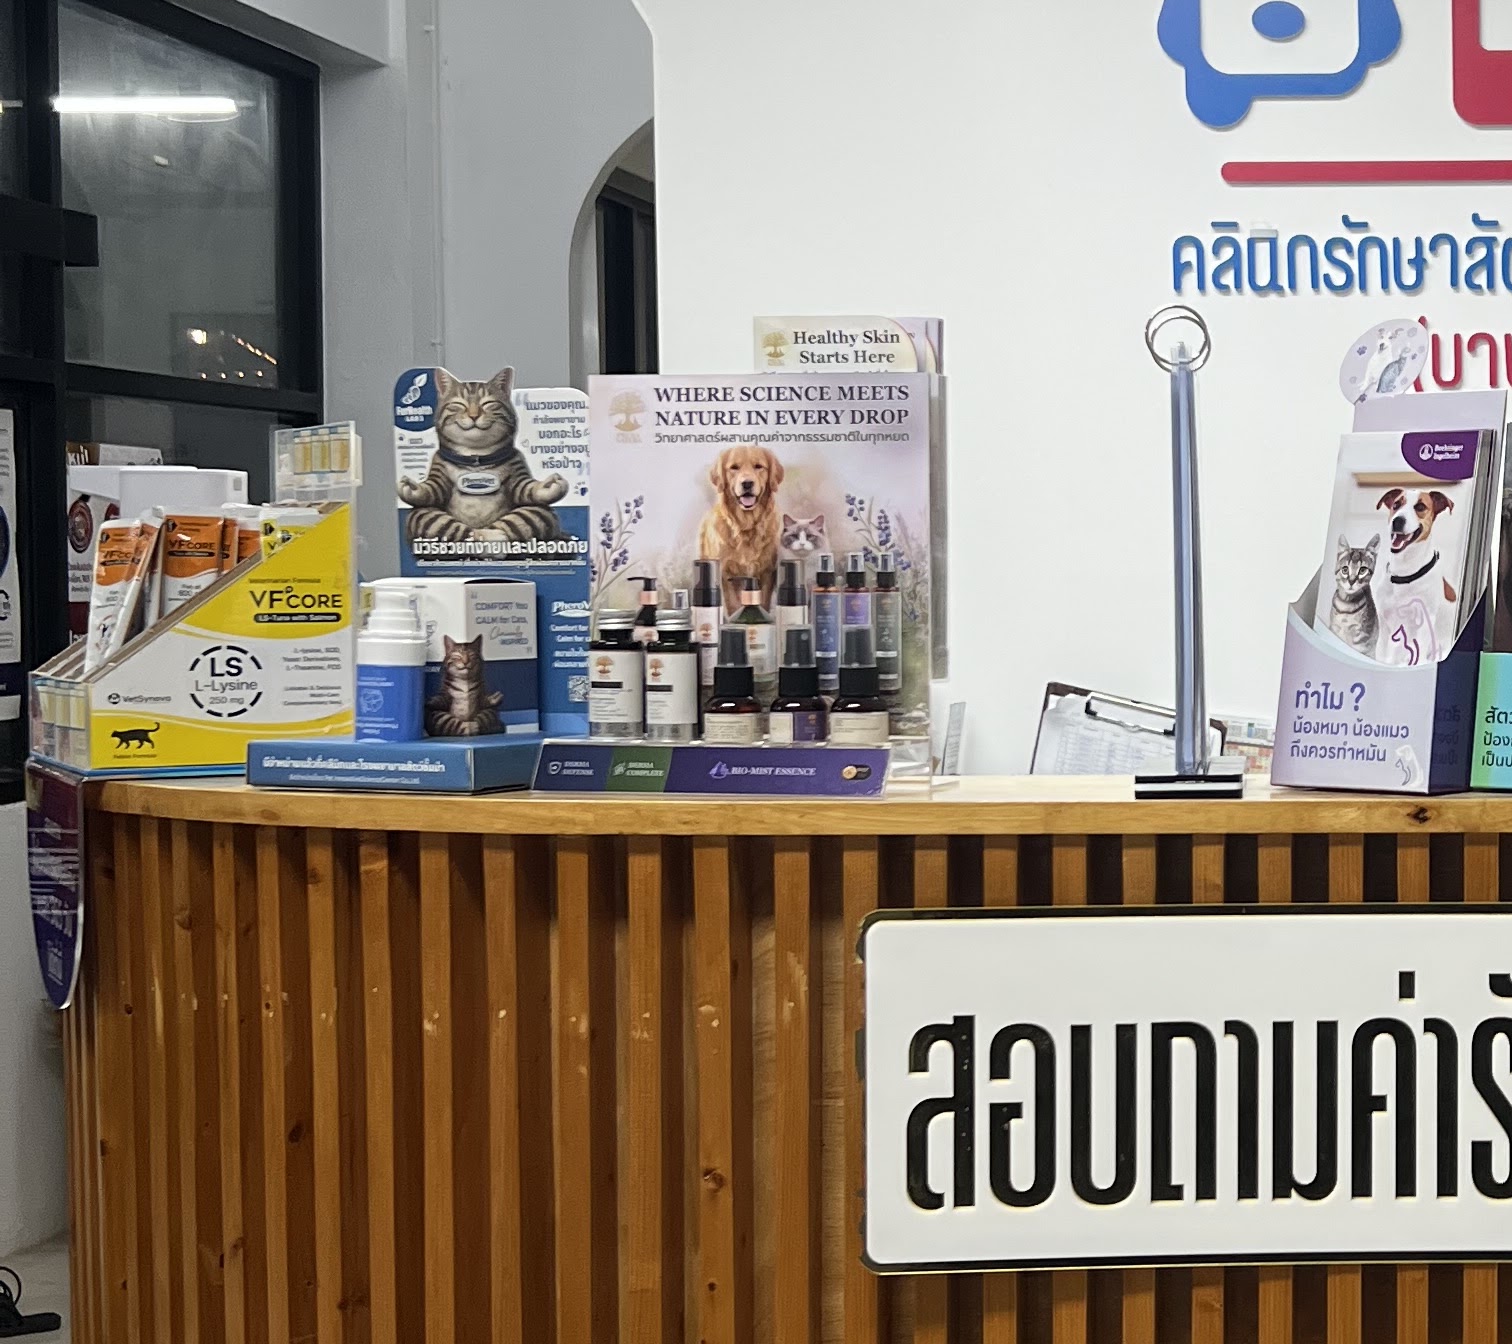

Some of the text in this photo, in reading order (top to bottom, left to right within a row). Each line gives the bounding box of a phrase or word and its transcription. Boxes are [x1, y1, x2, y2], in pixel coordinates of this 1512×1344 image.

[792, 329, 900, 347] Healthy Skin
[799, 350, 895, 364] Starts Here
[654, 384, 909, 403] WHERE SCIENCE MEETS
[654, 409, 909, 427] NATURE IN EVERY DROP
[551, 601, 592, 613] PheroV
[210, 657, 243, 677] LS
[194, 679, 258, 694] L-Lysine
[209, 695, 245, 708] 250 mg
[1295, 681, 1344, 711] ทำไม
[1293, 718, 1410, 740] น้องหมา น้องแมว
[1290, 739, 1387, 763] ถึงควรทำหมัน
[774, 766, 817, 777] ESSENCE
